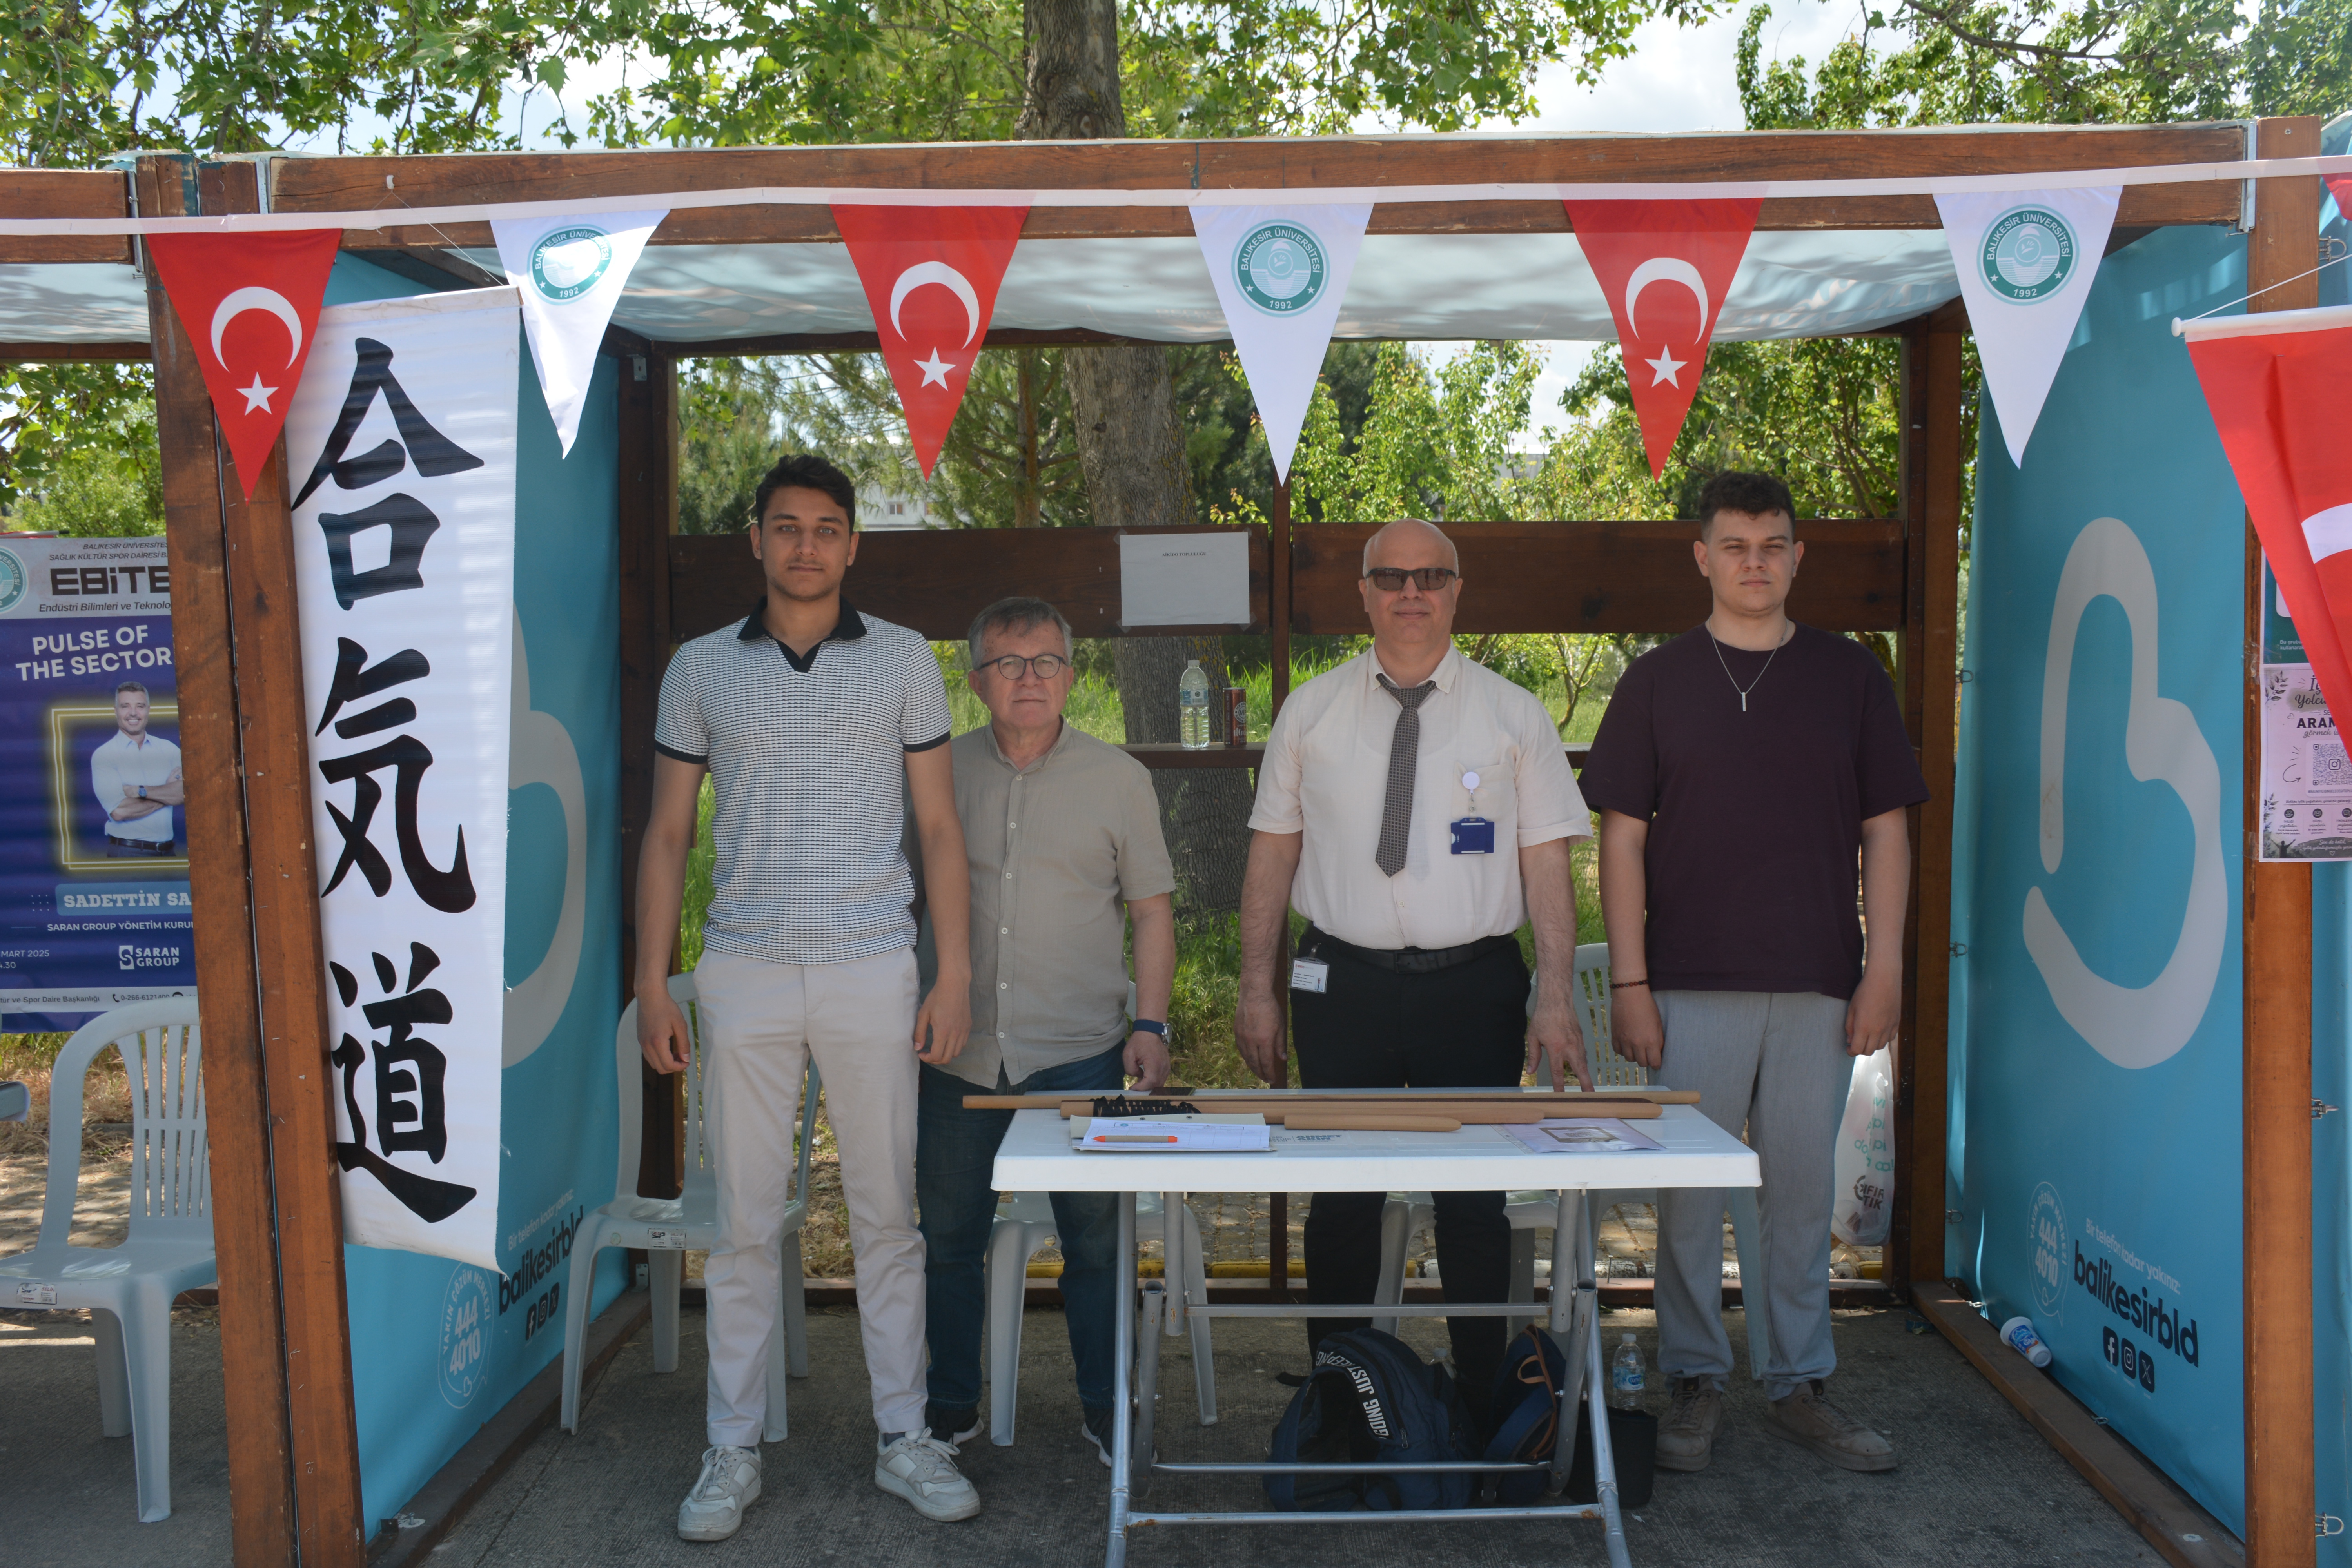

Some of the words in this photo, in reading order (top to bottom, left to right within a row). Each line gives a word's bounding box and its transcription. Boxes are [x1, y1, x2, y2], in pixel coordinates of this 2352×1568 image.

[535, 232, 567, 270] BALIKESİR
[1241, 230, 1272, 270] BALIKESİR
[1274, 227, 1322, 274] ÜNİVERSİTESİ
[1986, 216, 2021, 260] BALIKESİR
[2023, 212, 2071, 258] ÜNİVERSİTESİ
[559, 287, 579, 298] 1992
[1269, 300, 1292, 309] 1992
[2013, 288, 2038, 298] 1992
[39, 603, 78, 613] Endüstri
[81, 602, 118, 612] Bilimleri
[134, 601, 172, 612] Teknolo
[33, 629, 111, 655] PULSE
[116, 624, 149, 646] OF
[16, 659, 65, 681] THE
[71, 647, 172, 676] SECTOR
[2303, 729, 2332, 739] görmek
[290, 336, 485, 1224] 合気道
[64, 890, 160, 908] SADETTİN
[47, 923, 80, 931] SARAN
[82, 922, 116, 931] GROUP
[119, 920, 162, 930] YÖNETİM
[135, 947, 180, 957] SARAN
[136, 957, 180, 967] GROUP
[63, 995, 100, 1004] Başkanlığı
[2038, 1217, 2057, 1254] 444
[2086, 1218, 2095, 1238] Bir
[2096, 1225, 2122, 1258] telefon
[2121, 1243, 2145, 1272] kadar
[2035, 1246, 2058, 1287] 4010
[454, 1295, 479, 1339] 444
[2074, 1239, 2199, 1368] balikesirbld
[449, 1327, 481, 1376] 4010
[1346, 1366, 1375, 1394] JUST
[1363, 1398, 1389, 1436] GOING
